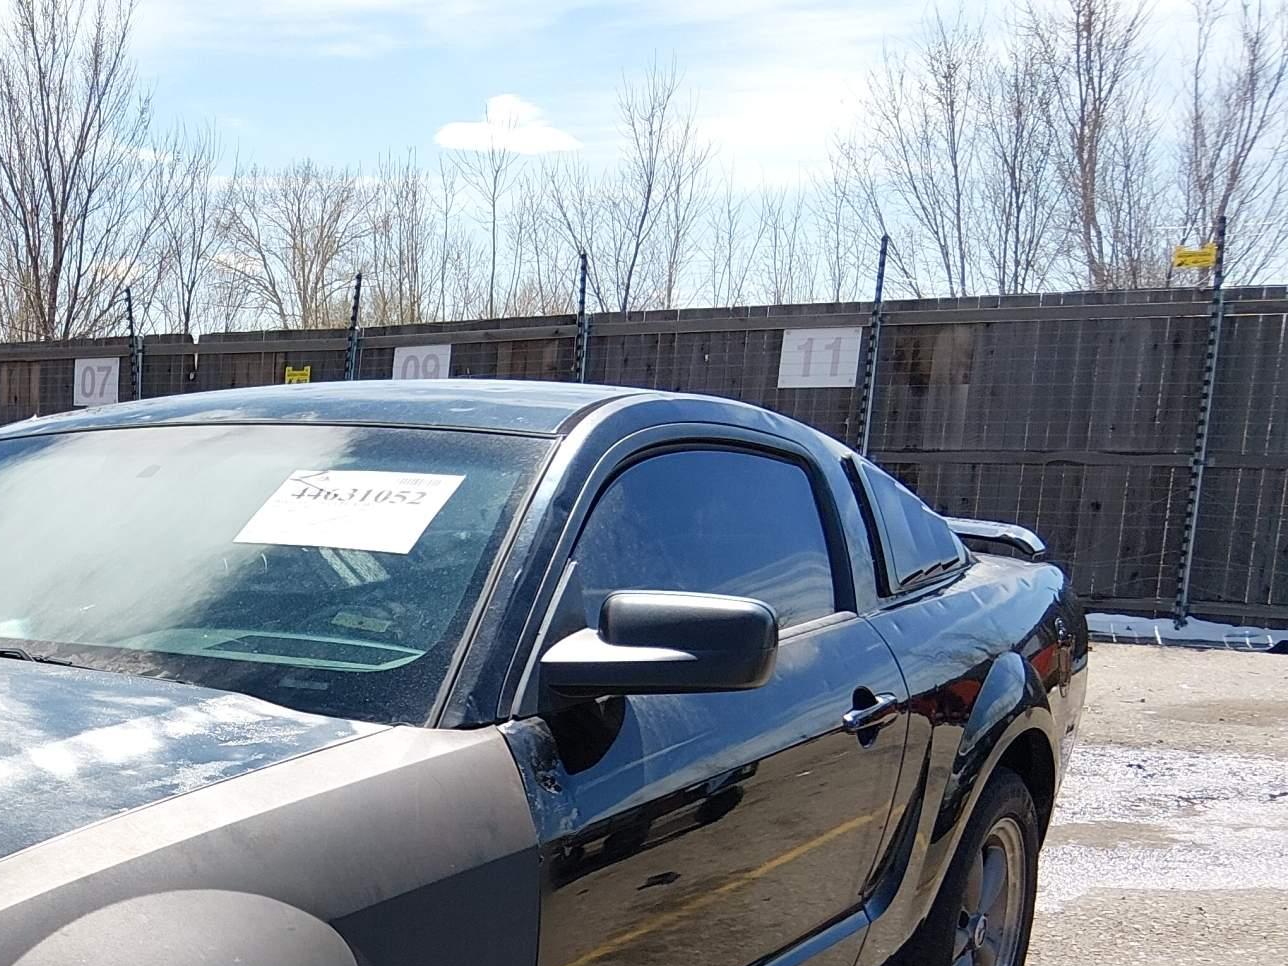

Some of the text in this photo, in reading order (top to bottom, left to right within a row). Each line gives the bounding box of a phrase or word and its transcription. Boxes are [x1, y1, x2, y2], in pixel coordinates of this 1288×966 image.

[797, 337, 841, 377] 11
[81, 366, 113, 398] 07
[290, 487, 428, 505] 44631052
